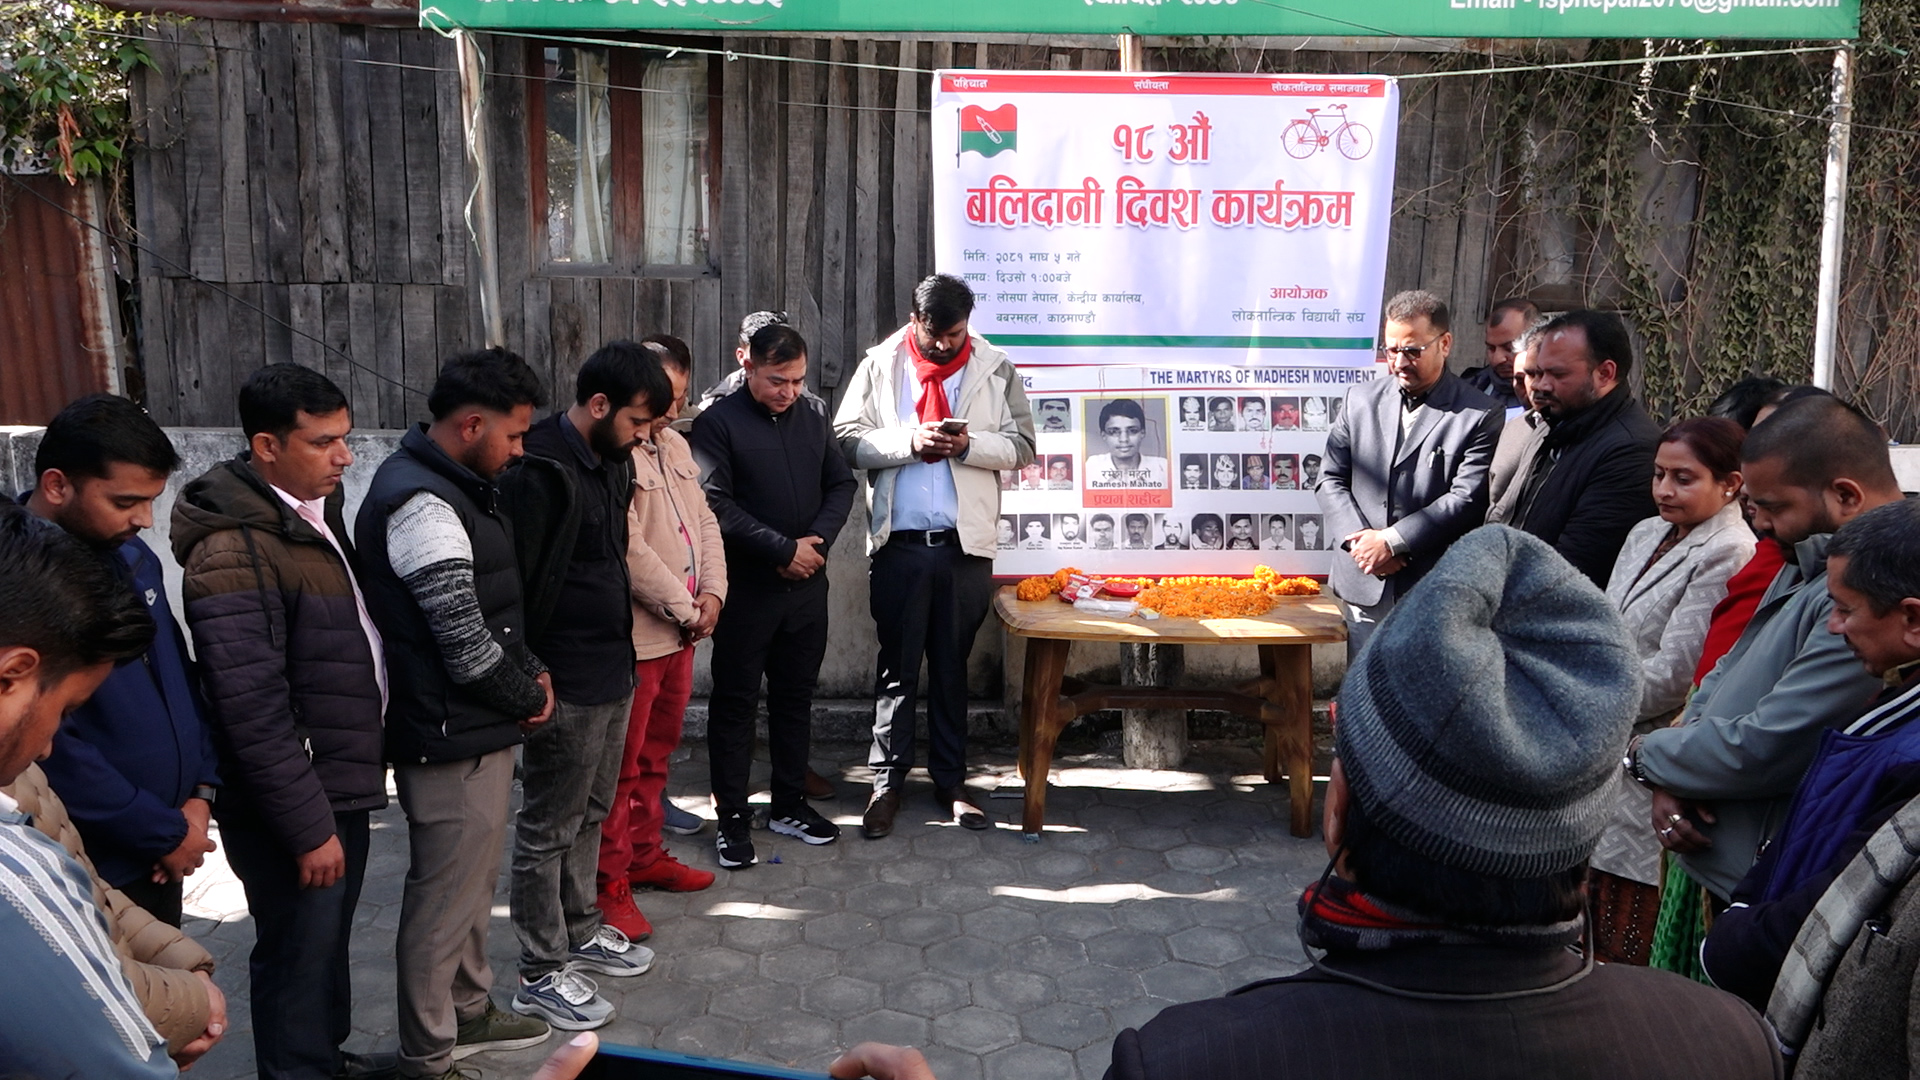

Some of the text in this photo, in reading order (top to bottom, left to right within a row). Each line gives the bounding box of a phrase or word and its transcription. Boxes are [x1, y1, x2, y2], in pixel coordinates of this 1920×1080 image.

[1113, 124, 1154, 160] १८
[966, 174, 1355, 228] बलिदानी दिवश कार्यक्रम
[996, 252, 1023, 264] २०८१
[1029, 252, 1049, 262] माघ
[1054, 253, 1061, 264] ५
[1067, 250, 1081, 262] गते
[996, 270, 1026, 283] दिउसो
[996, 291, 1027, 303] लोसपा
[1270, 285, 1328, 299] आयोजक
[1232, 308, 1366, 324] लोकतान्त्रिक विद्यार्थी संघ
[1150, 369, 1377, 385] THE MARTYRS OF MADHESH MOVEMENT
[1092, 480, 1162, 488] Ramesh Mahato
[1094, 492, 1162, 505] प्रथम शहीद
